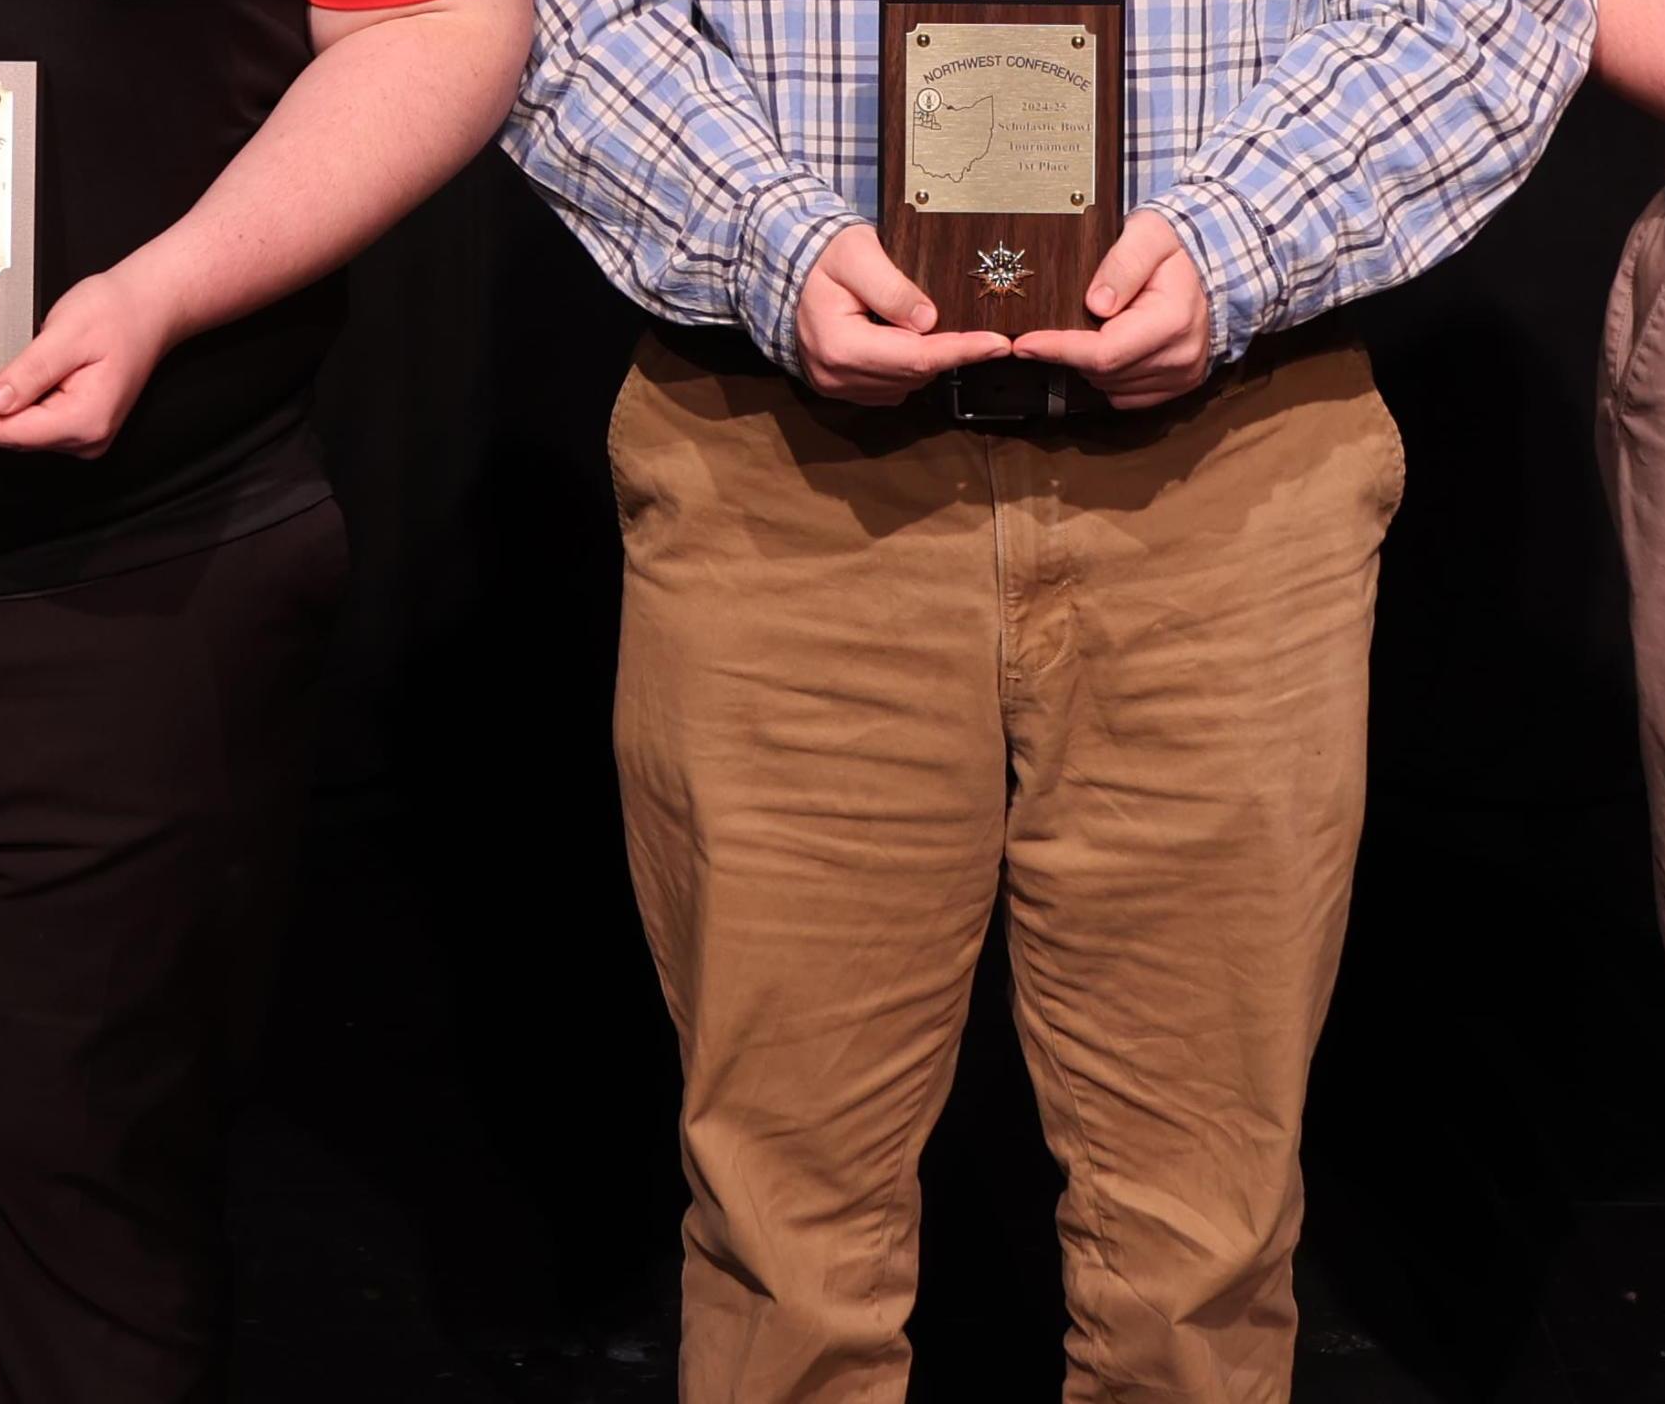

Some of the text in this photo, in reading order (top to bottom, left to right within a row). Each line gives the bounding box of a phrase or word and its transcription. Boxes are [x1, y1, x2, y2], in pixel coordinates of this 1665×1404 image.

[923, 55, 1092, 92] NORTHWEST CONFERENCE
[1022, 102, 1067, 112] 2024-25
[998, 122, 1092, 132] Scholastic Bowl
[1009, 142, 1080, 152] Tournament
[1019, 162, 1070, 172] 1st Place
